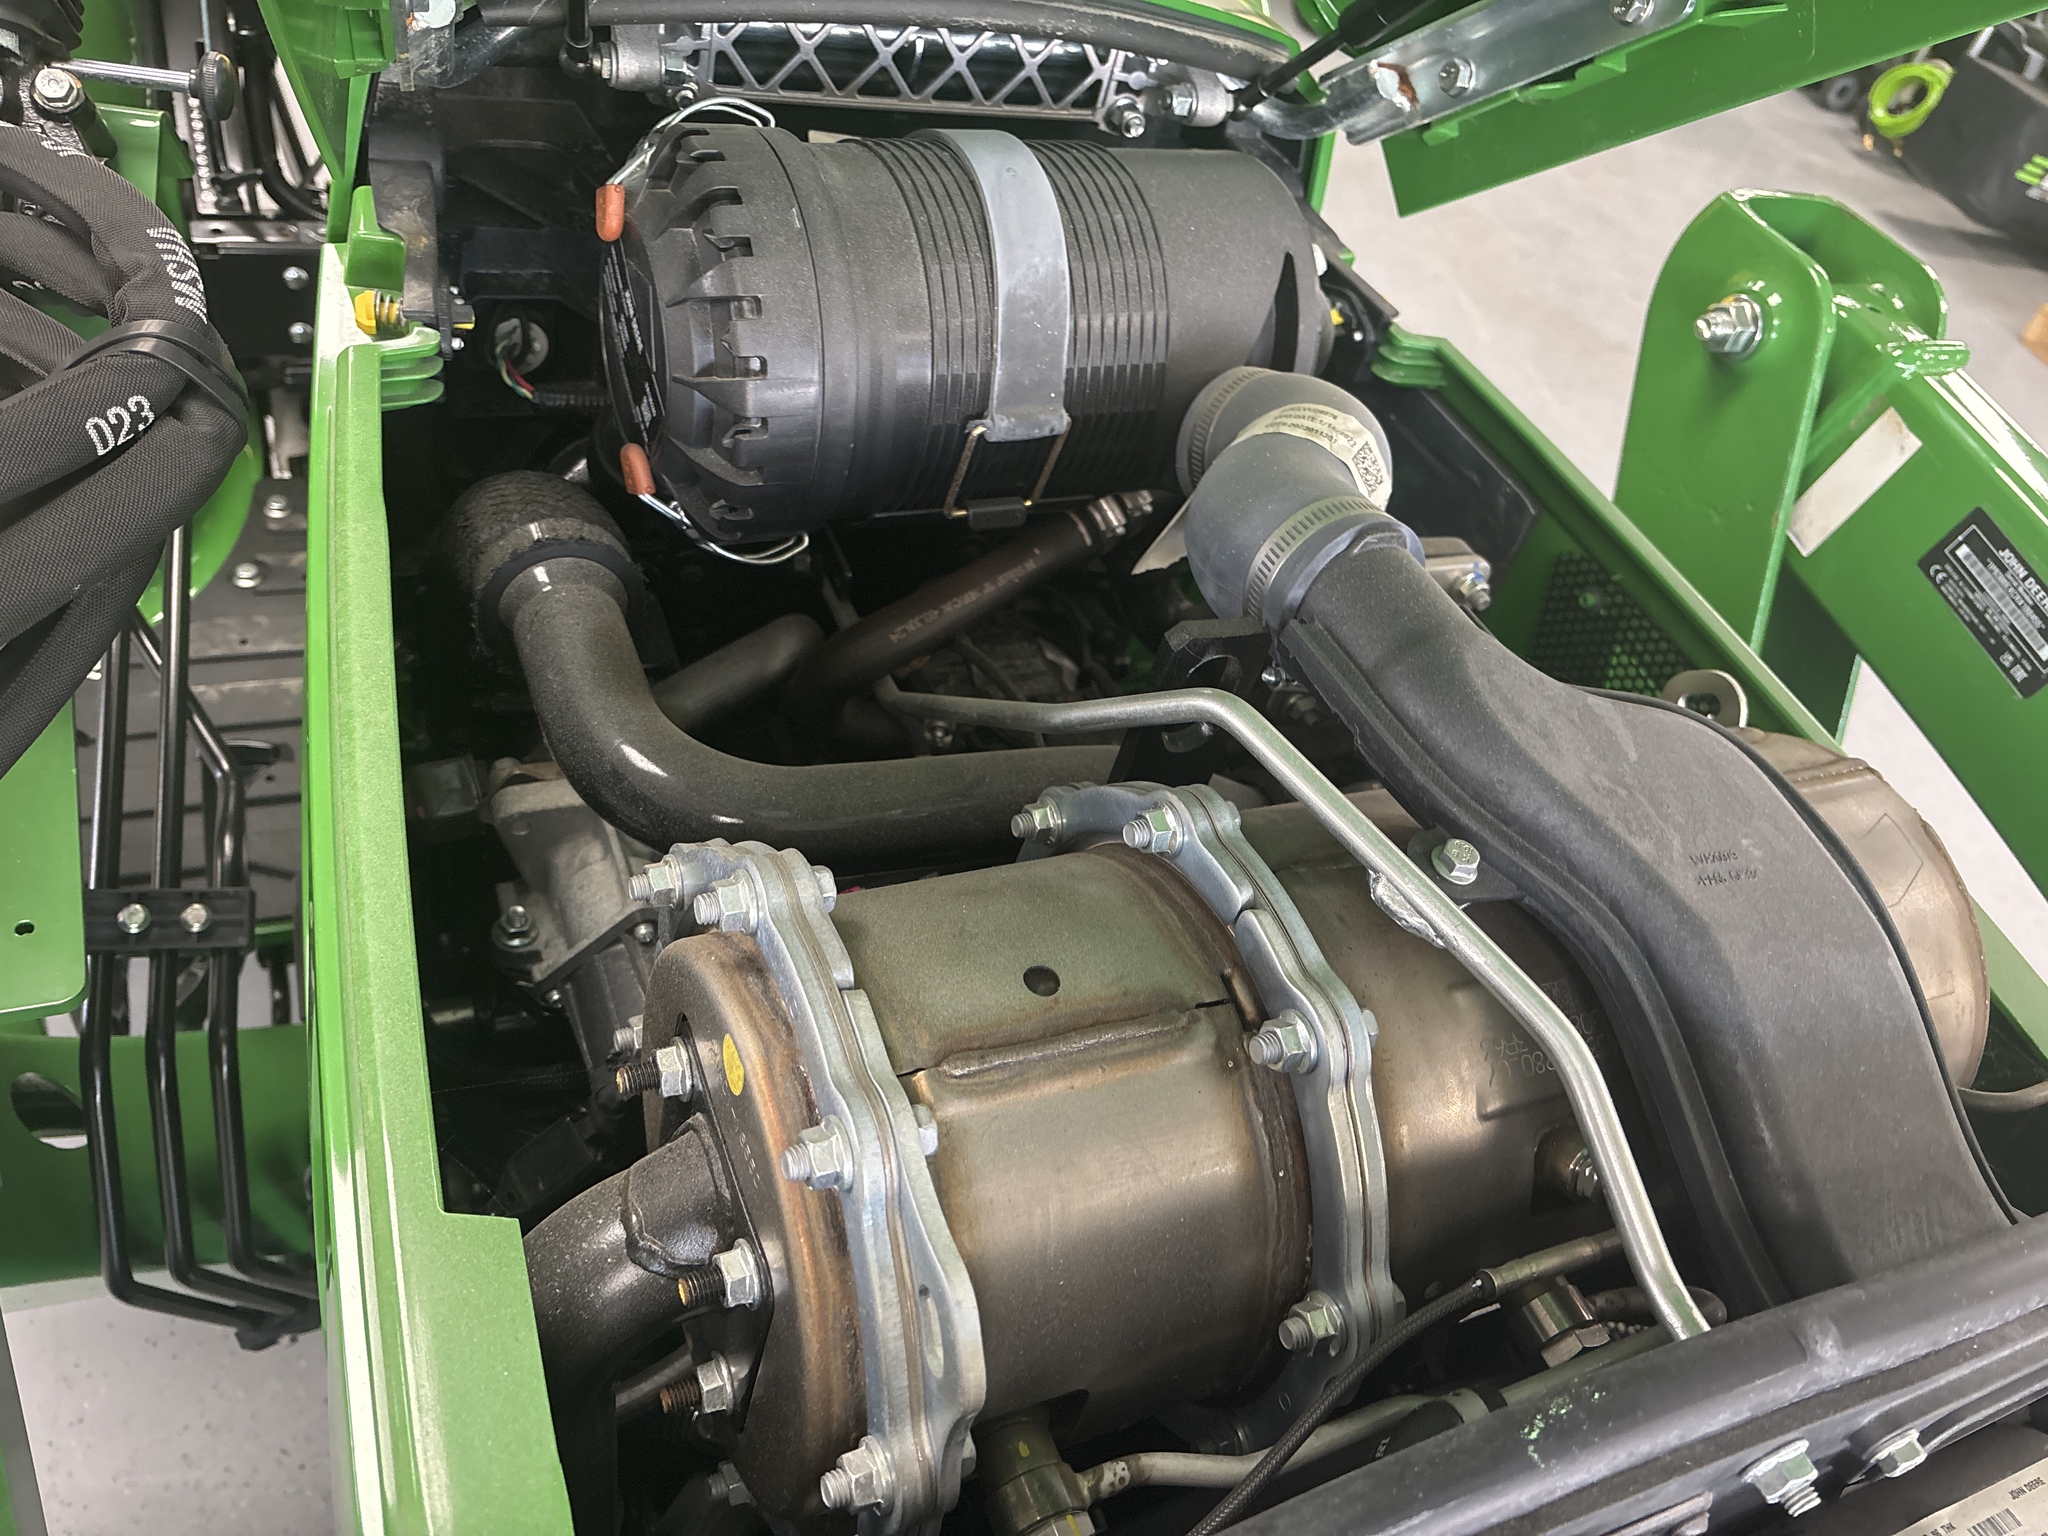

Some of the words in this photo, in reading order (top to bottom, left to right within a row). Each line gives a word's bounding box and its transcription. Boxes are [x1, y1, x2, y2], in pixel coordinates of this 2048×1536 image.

[85, 395, 155, 456] D23
[1999, 548, 2029, 580] JOHN
[2008, 1486, 2028, 1500] JOHN
[2023, 1477, 2046, 1492] DEERE
